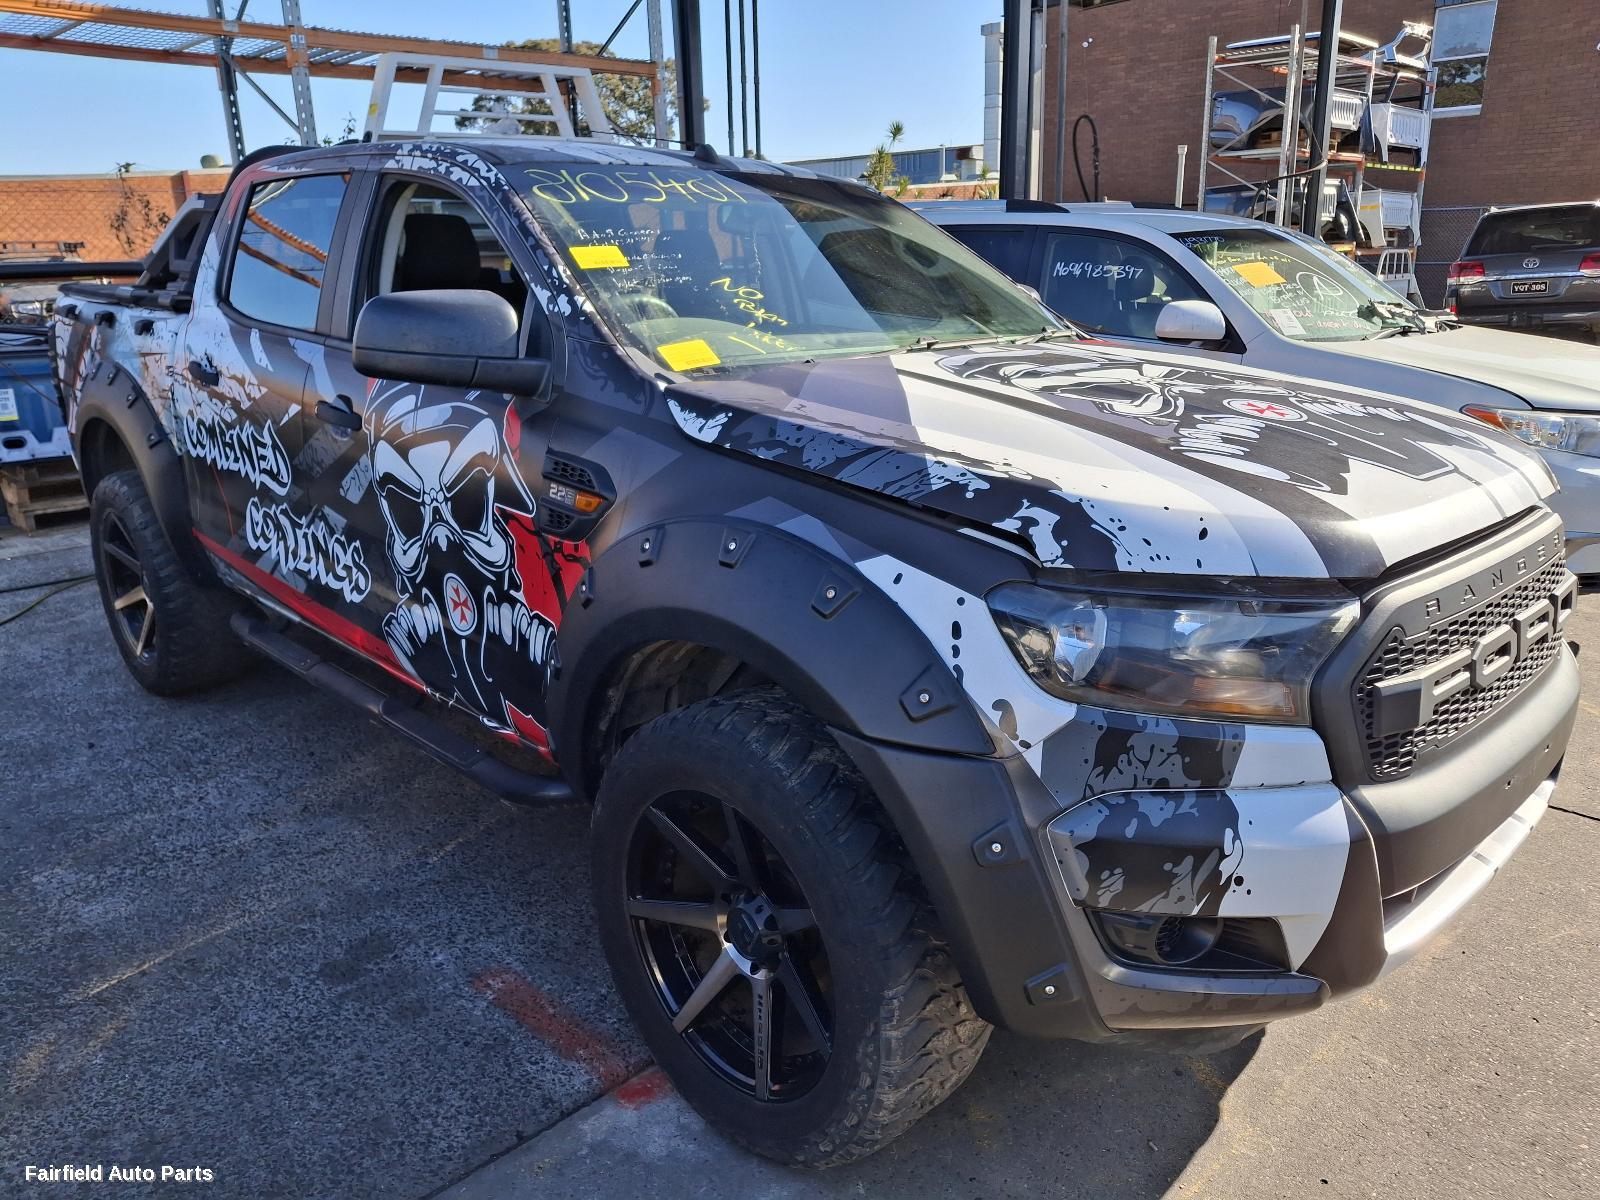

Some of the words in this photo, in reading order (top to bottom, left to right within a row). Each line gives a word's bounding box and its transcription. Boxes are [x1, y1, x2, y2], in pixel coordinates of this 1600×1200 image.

[184, 413, 291, 497] COMBINED
[245, 496, 372, 604] COATINGS
[1425, 532, 1562, 619] RANGER
[1373, 567, 1579, 738] FORD
